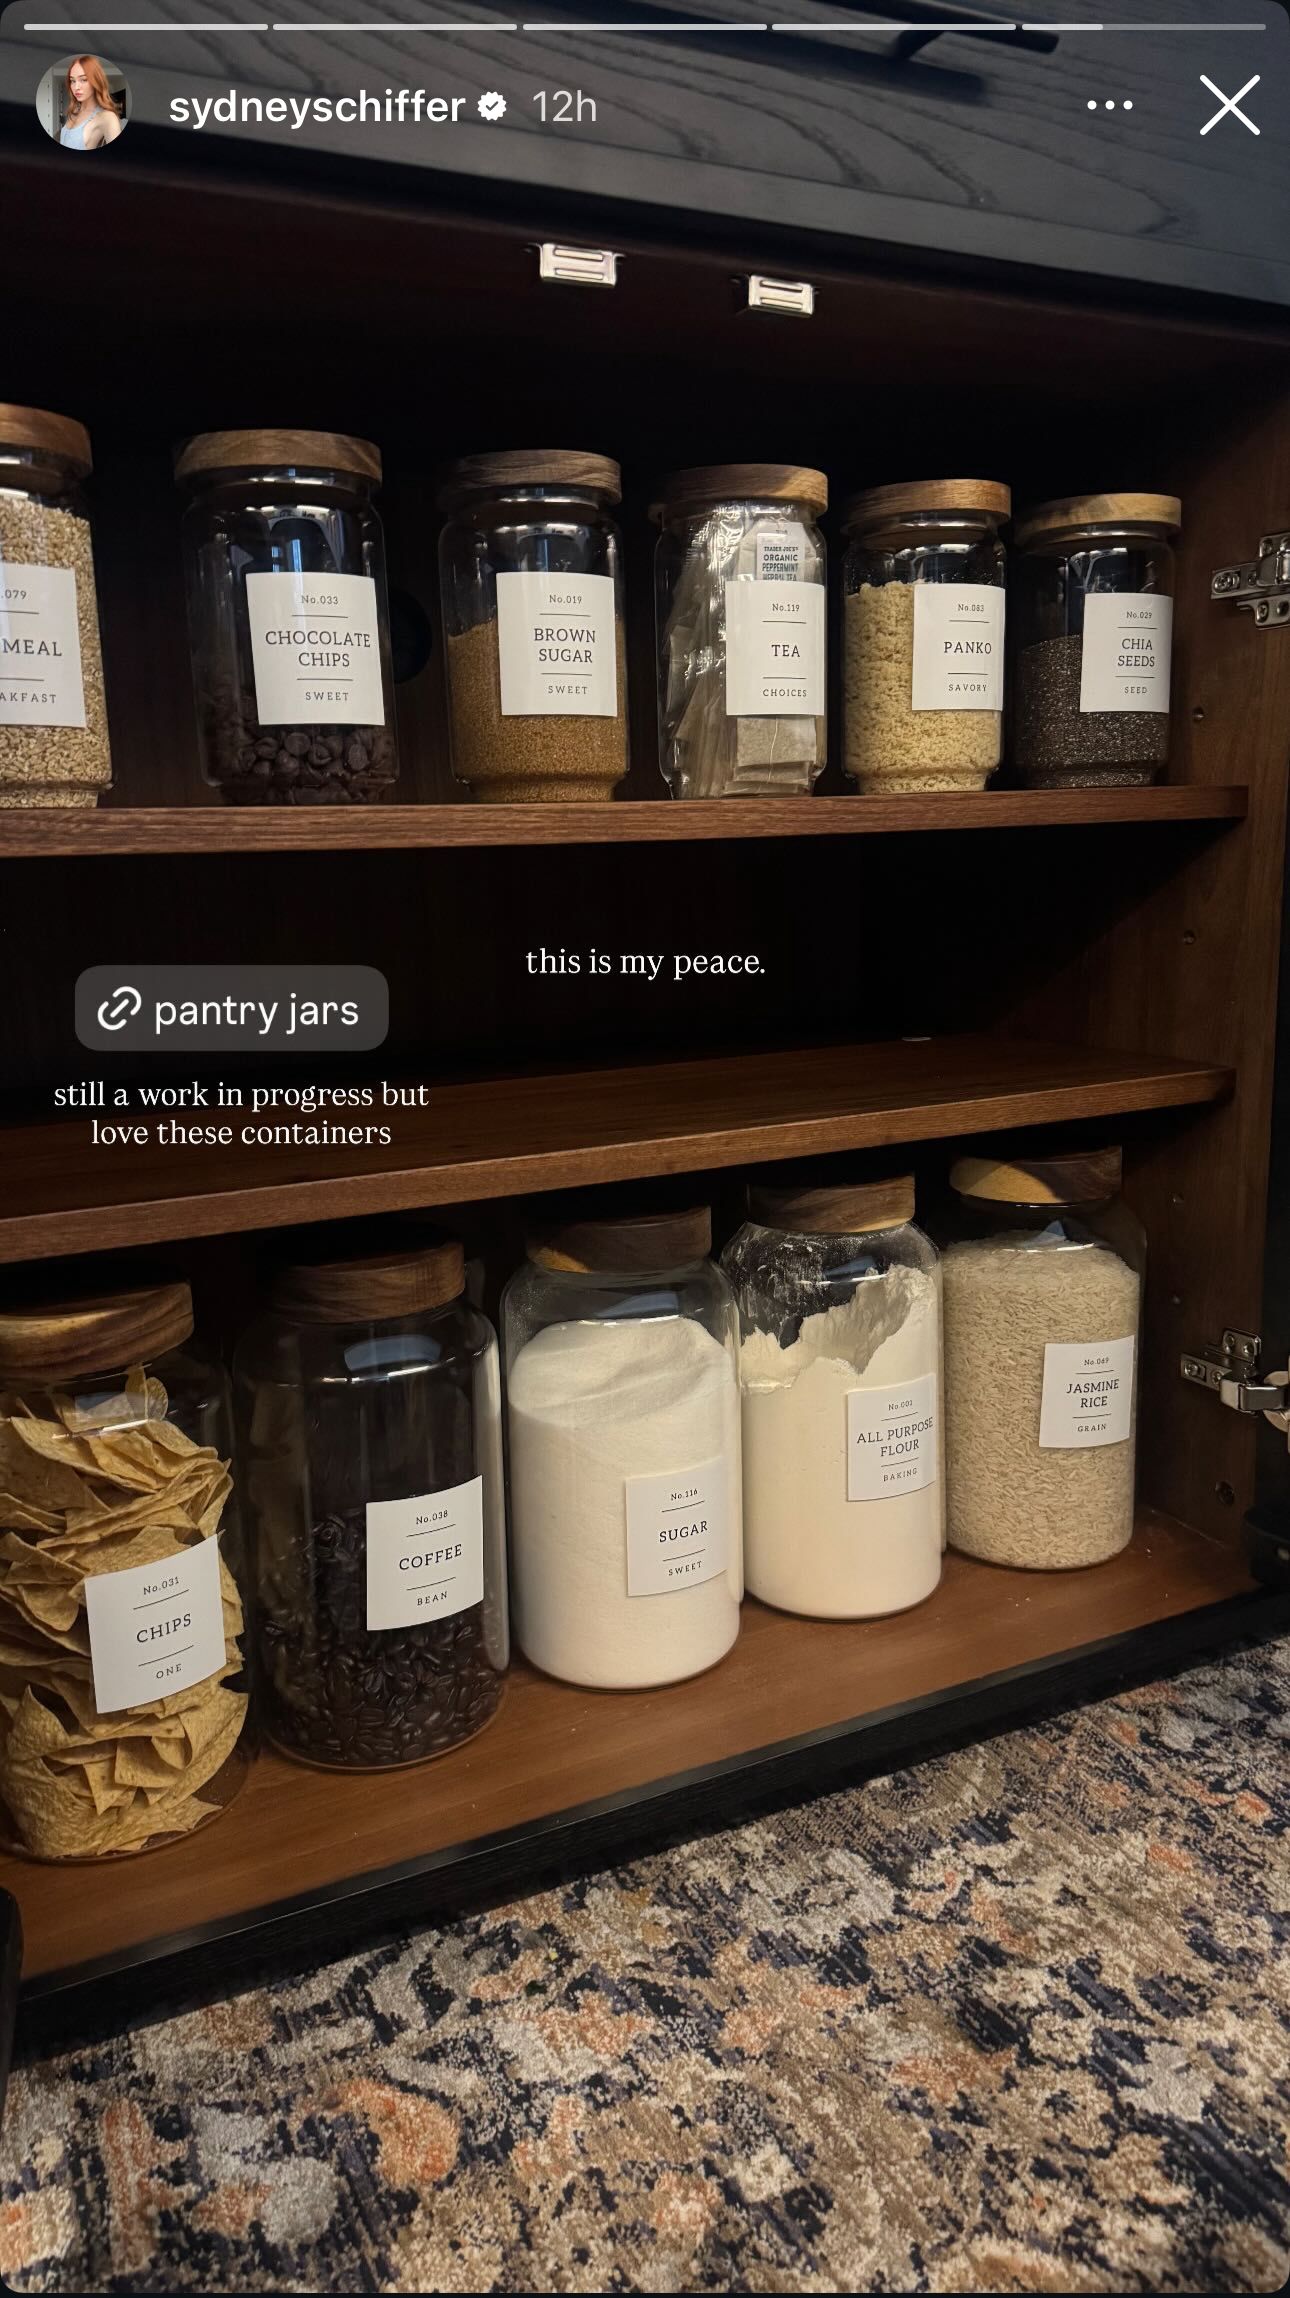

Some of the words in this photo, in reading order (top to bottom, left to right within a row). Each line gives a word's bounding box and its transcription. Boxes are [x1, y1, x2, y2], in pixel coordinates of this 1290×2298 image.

[763, 554, 798, 562] ORGANIC
[762, 563, 799, 572] PEPPERMINT
[300, 595, 339, 605] No.033
[549, 595, 583, 604] No.019
[265, 630, 371, 648] CHOCOLATE
[534, 628, 596, 643] BROWN
[771, 644, 801, 658] TEA
[943, 641, 992, 655] PANKO
[1121, 638, 1153, 650] CHIA
[298, 652, 350, 667] CHIPS
[538, 648, 593, 664] SUGAR
[1117, 655, 1155, 667] SEEDS
[548, 685, 588, 695] SWEET
[762, 689, 807, 697] CHOICES
[948, 684, 987, 692] SAVORY
[1124, 686, 1148, 694] SEED
[305, 691, 349, 701] SWEET
[1066, 1378, 1120, 1394] JASMINE
[1080, 1396, 1108, 1408] RICE
[856, 1431, 884, 1444] ALL
[887, 1416, 934, 1441] PURPOSE
[1077, 1423, 1107, 1432] GRAIN
[880, 1438, 920, 1457] FLOUR
[883, 1467, 918, 1482] BAKING
[415, 1509, 449, 1525] No.038
[659, 1520, 708, 1543] SUGAR
[399, 1543, 463, 1571] COFFEE
[668, 1560, 702, 1576] SWEET
[143, 1576, 180, 1596] No.031
[416, 1590, 448, 1606] BEAN
[136, 1613, 192, 1644] CHIPS
[155, 1663, 183, 1680] ONE
